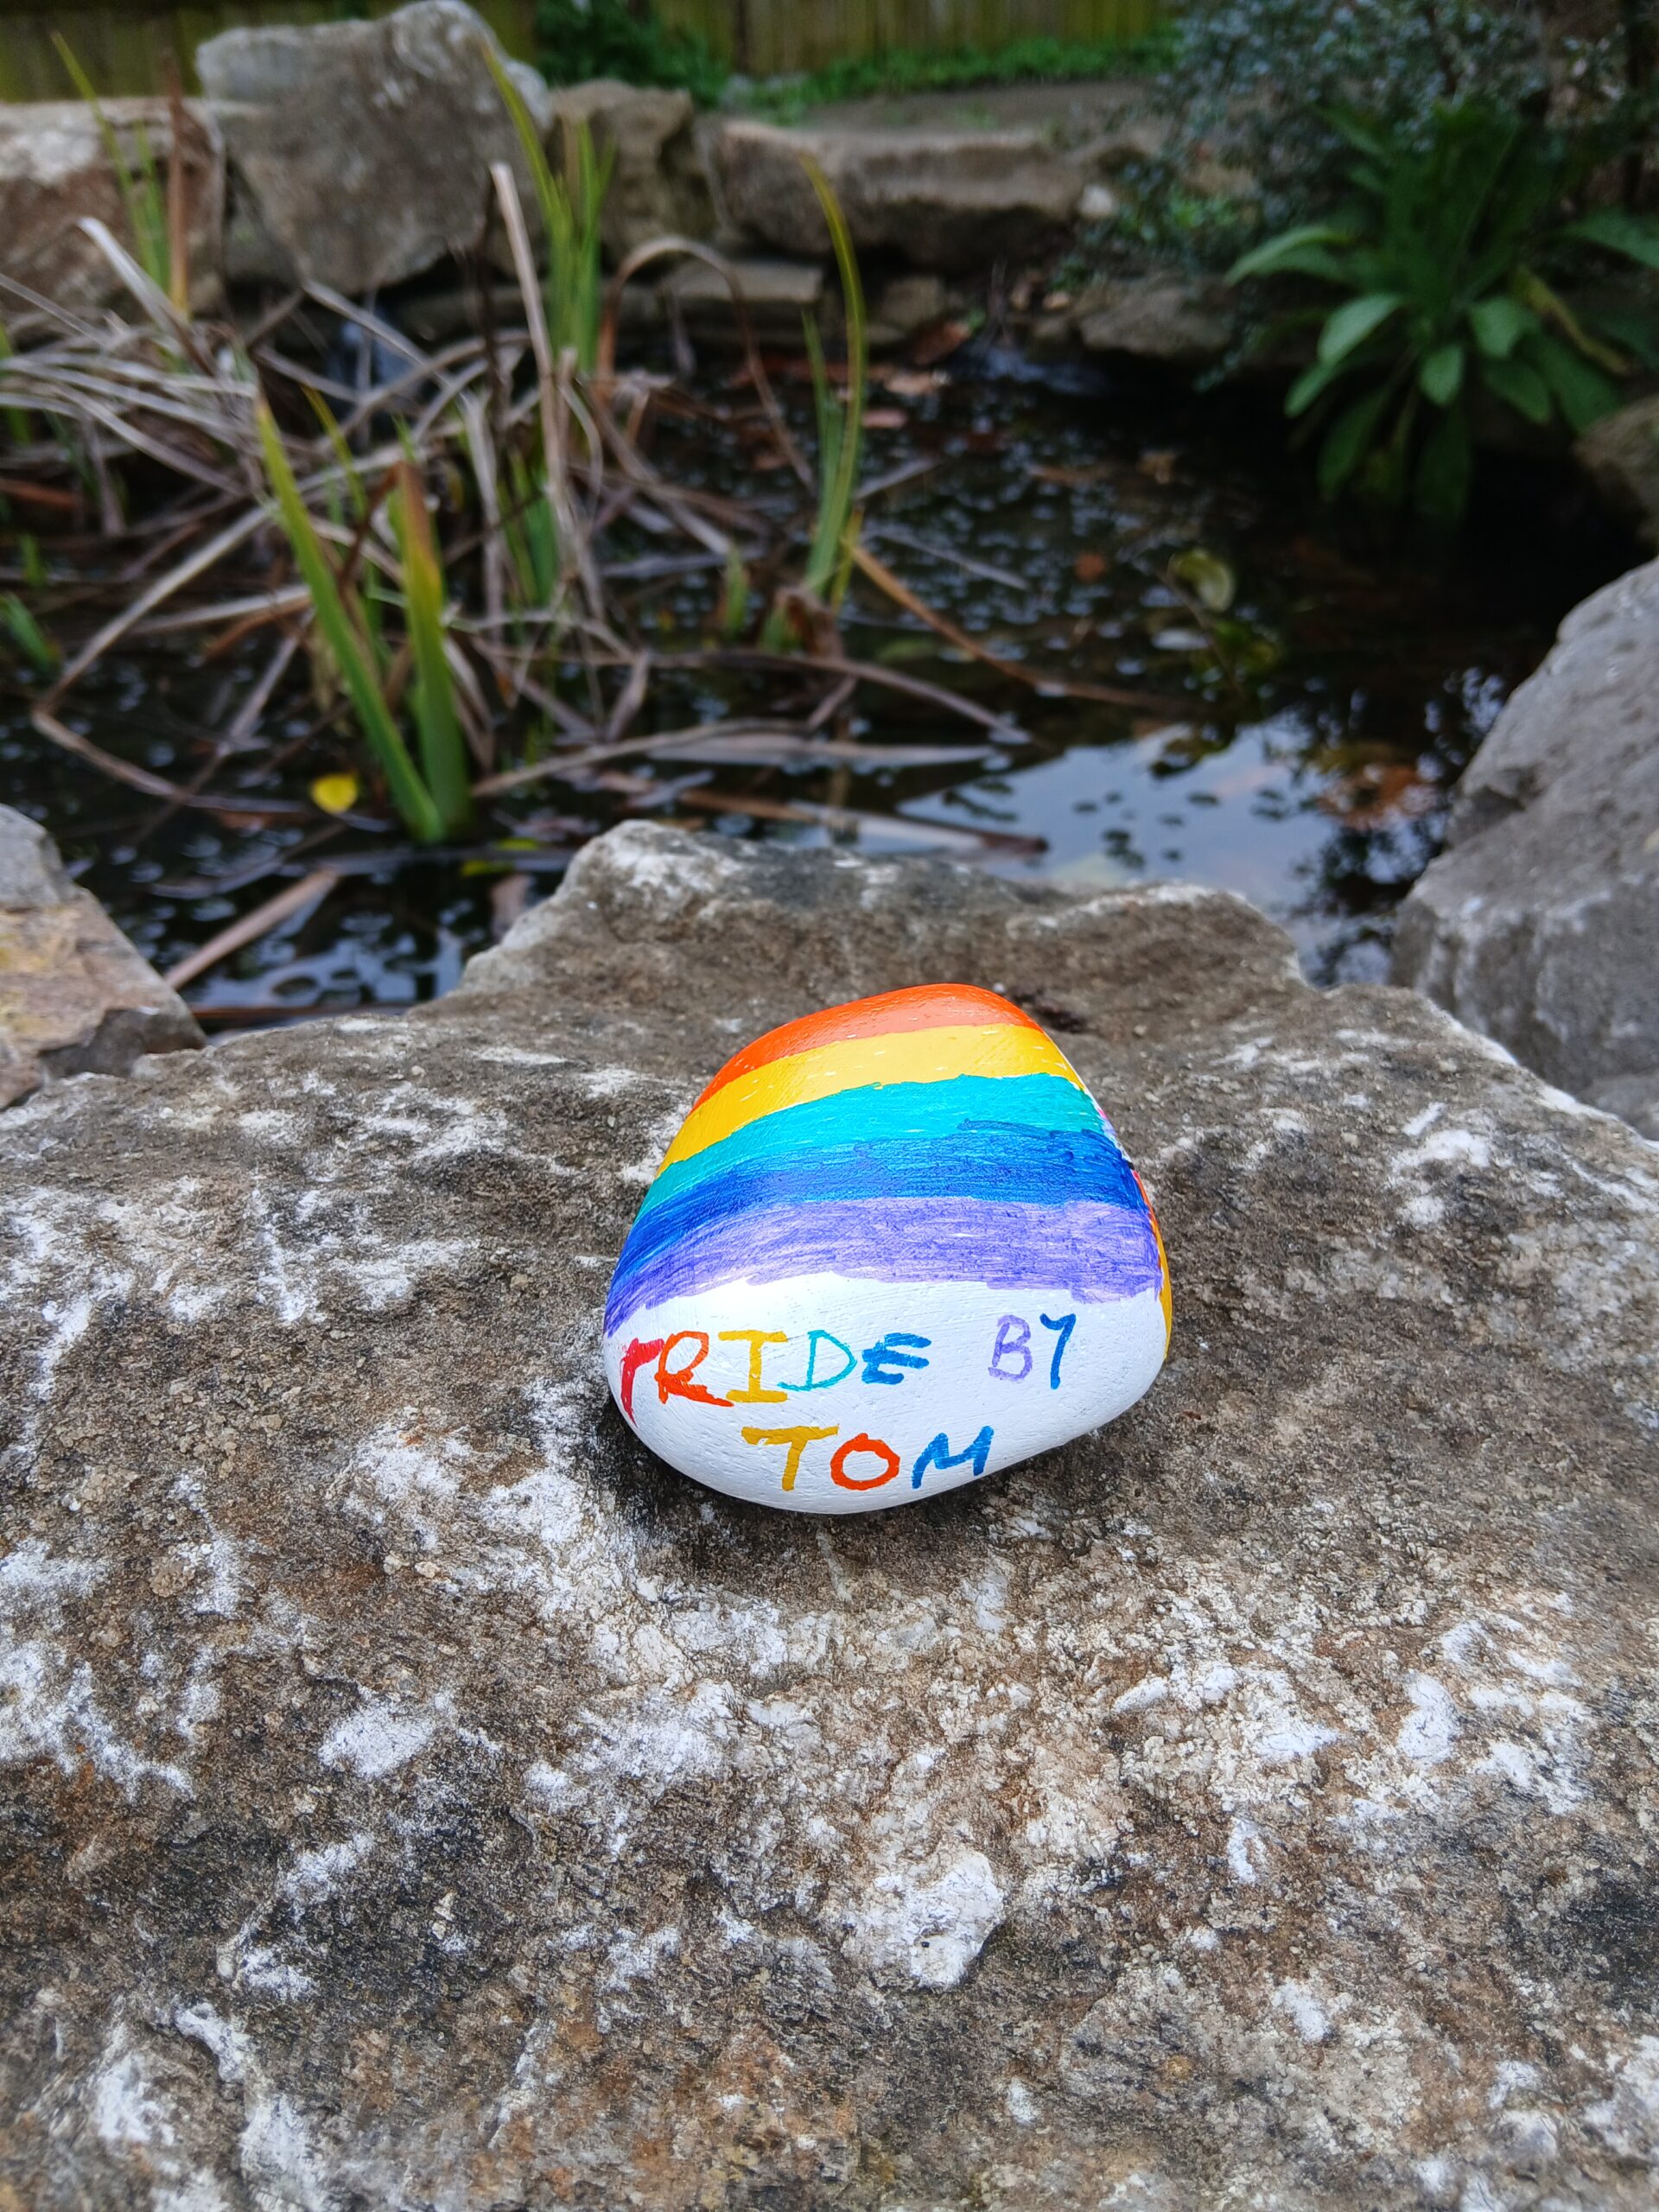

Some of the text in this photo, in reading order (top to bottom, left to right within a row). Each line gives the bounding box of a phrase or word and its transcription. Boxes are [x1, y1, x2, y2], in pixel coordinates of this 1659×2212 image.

[620, 1312, 1077, 1427] PRIDE BY
[741, 1424, 995, 1491] TOM
